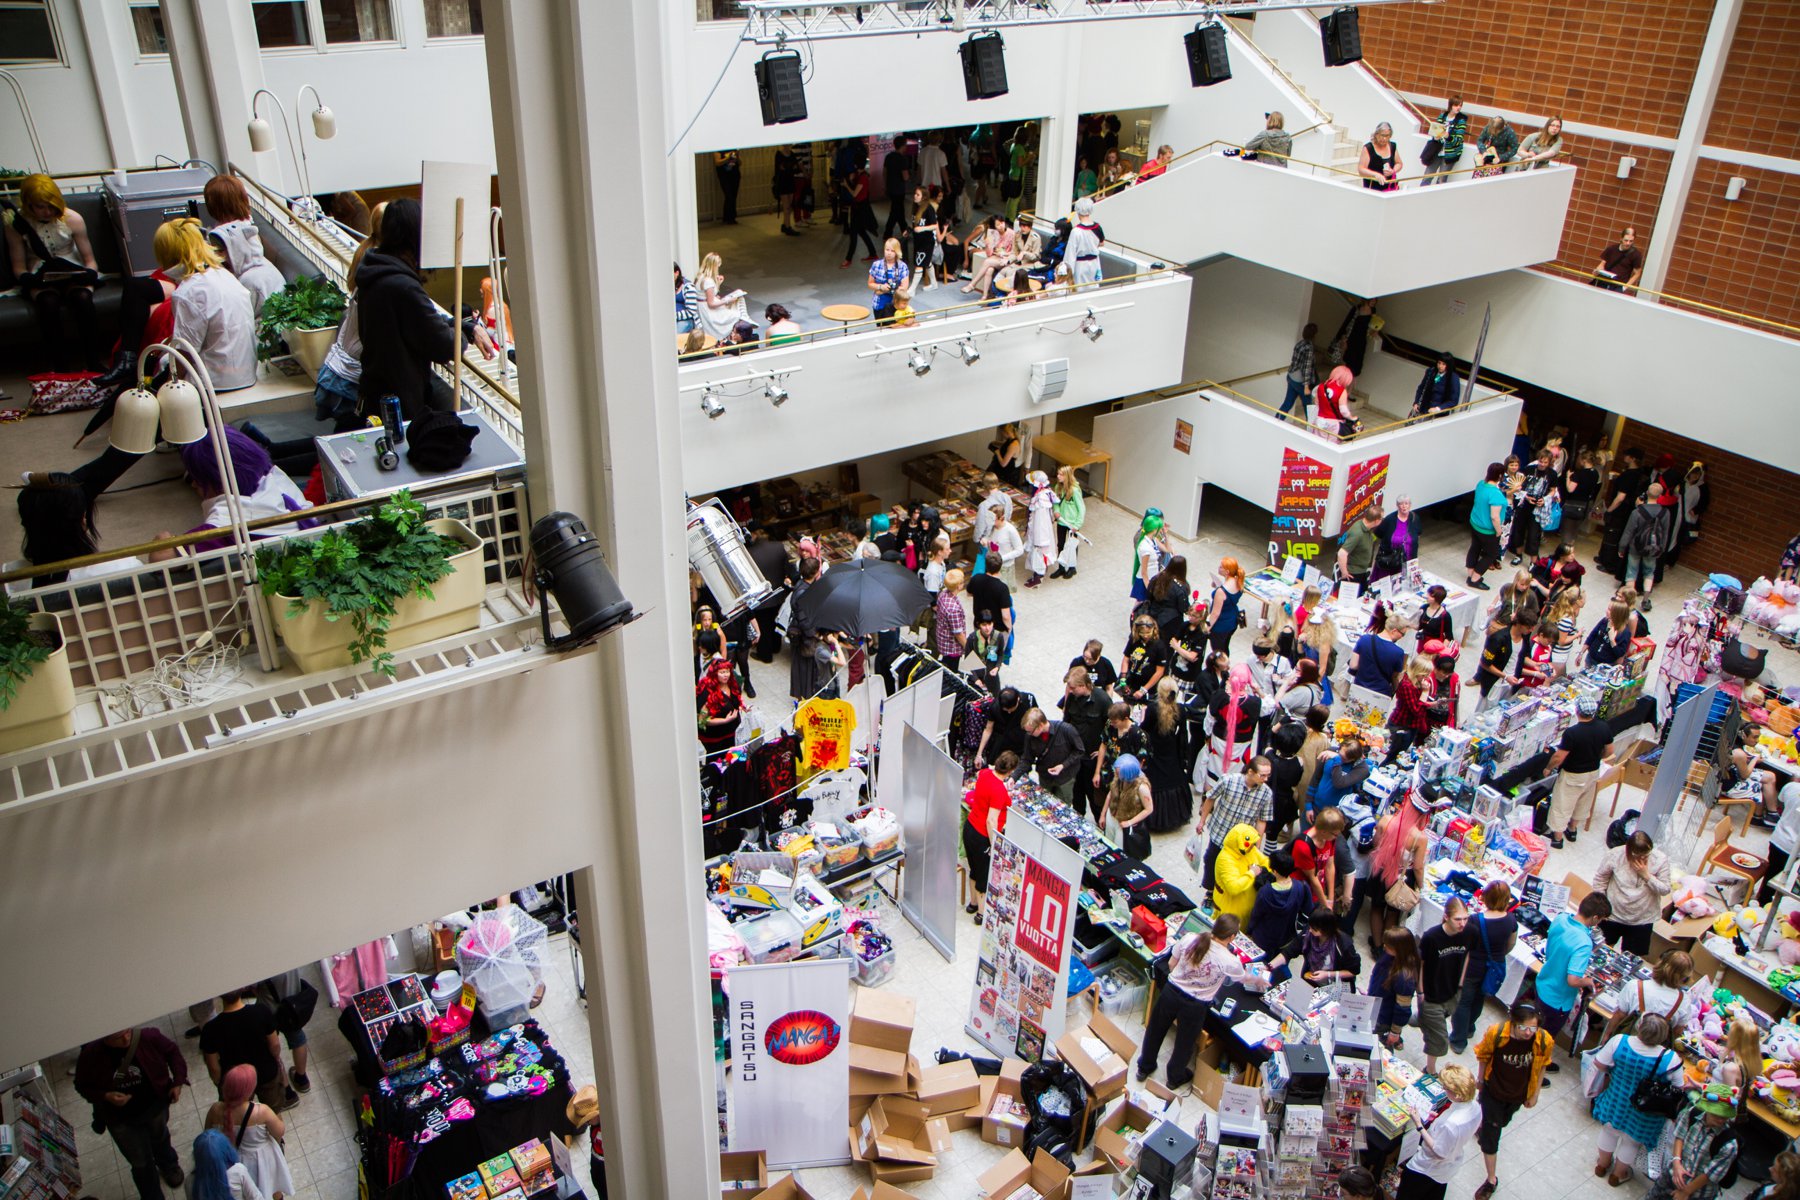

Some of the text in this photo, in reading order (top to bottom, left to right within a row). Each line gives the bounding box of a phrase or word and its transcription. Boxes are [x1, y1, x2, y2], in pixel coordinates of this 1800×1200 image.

[1027, 861, 1066, 901] MANGA
[1020, 919, 1058, 958] VUOTTA
[740, 1001, 757, 1082] SANGATSU
[767, 1024, 841, 1056] MANGA!
